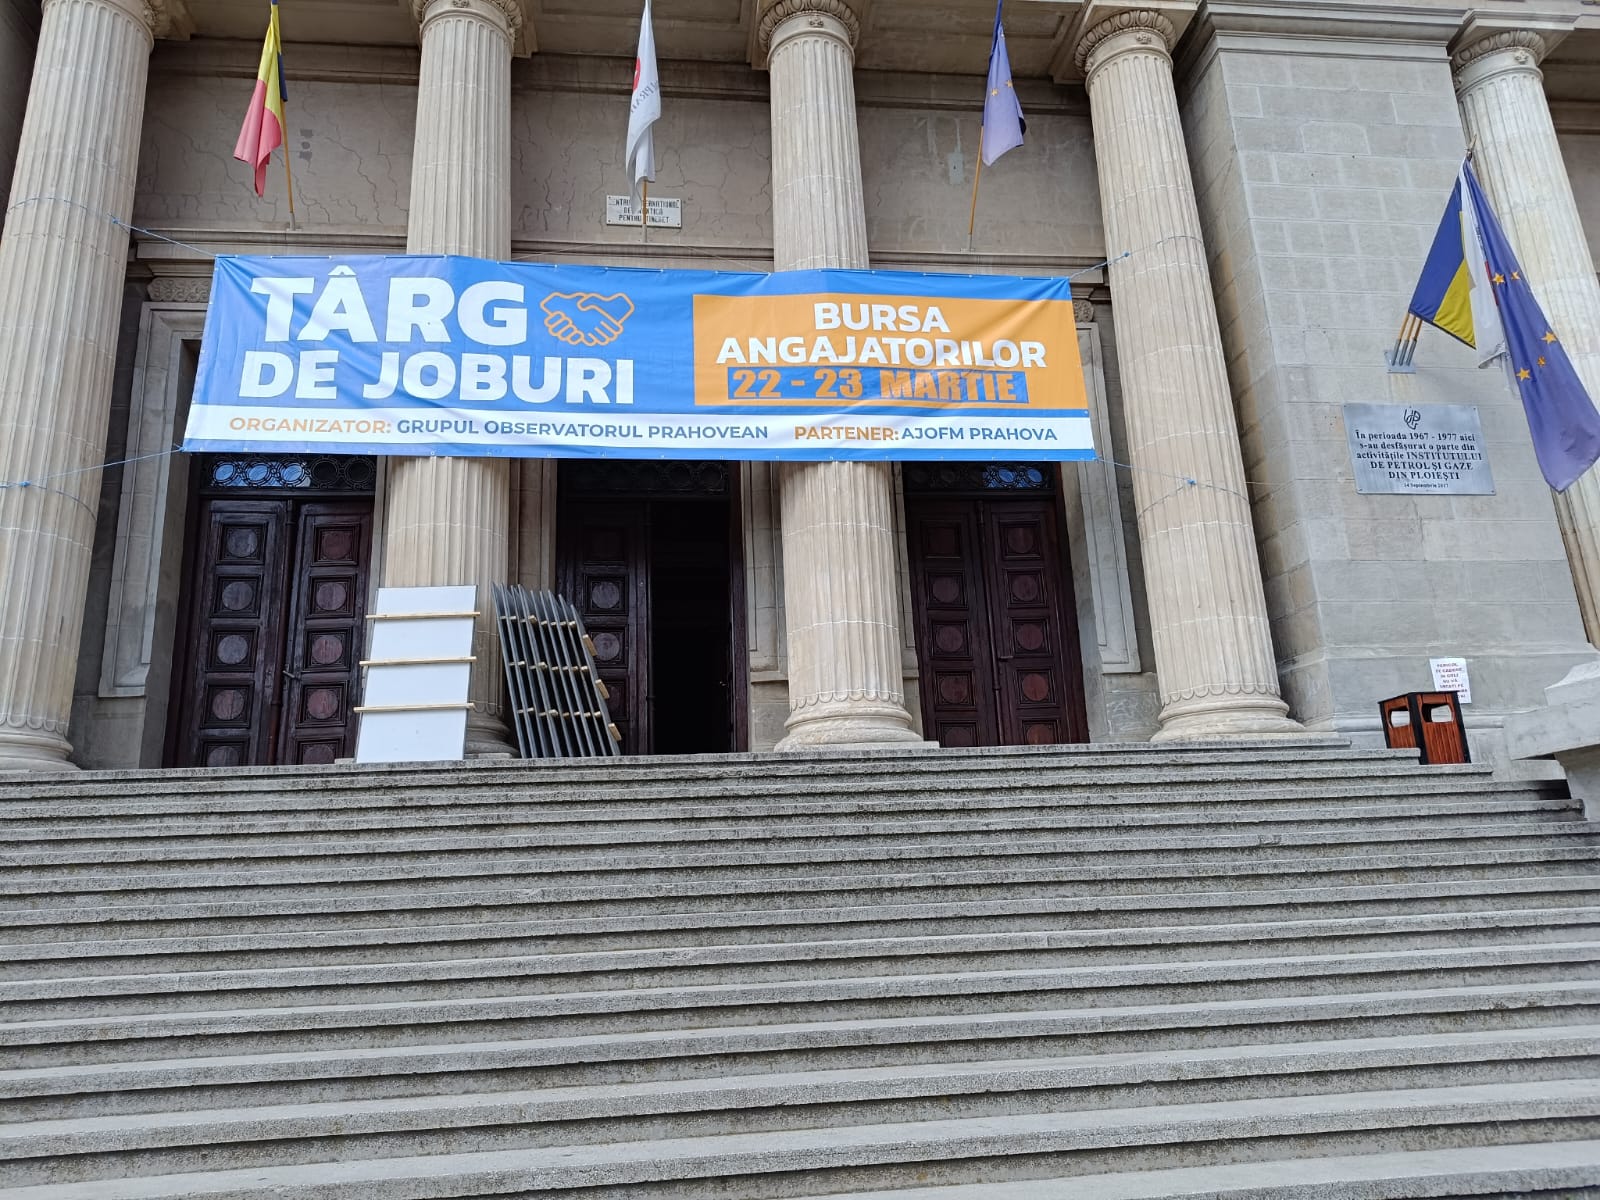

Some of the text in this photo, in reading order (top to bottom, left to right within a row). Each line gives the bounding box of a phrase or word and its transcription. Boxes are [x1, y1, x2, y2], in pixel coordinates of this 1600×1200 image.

[250, 264, 528, 347] TÂRG
[813, 302, 950, 333] BURSA
[716, 336, 1048, 368] ANGAJATORILOR
[238, 349, 634, 404] DE JOBURI
[733, 369, 781, 399] 22
[813, 368, 863, 398] 23
[880, 370, 1017, 401] MARTIE
[229, 417, 768, 439] ORGANIZATOR: GRUPUL OBSERVATORUL PRAHOVEAN
[794, 425, 1058, 441] PARTENER: AJOFM PRAHOVA
[1368, 432, 1407, 441] perioada
[1438, 432, 1456, 440] 1977
[1460, 433, 1475, 441] aici
[1406, 452, 1482, 460] INSTITUTULUI
[1436, 444, 1460, 452] parte
[1388, 461, 1430, 470] PETROL
[1444, 462, 1473, 470] GAZE
